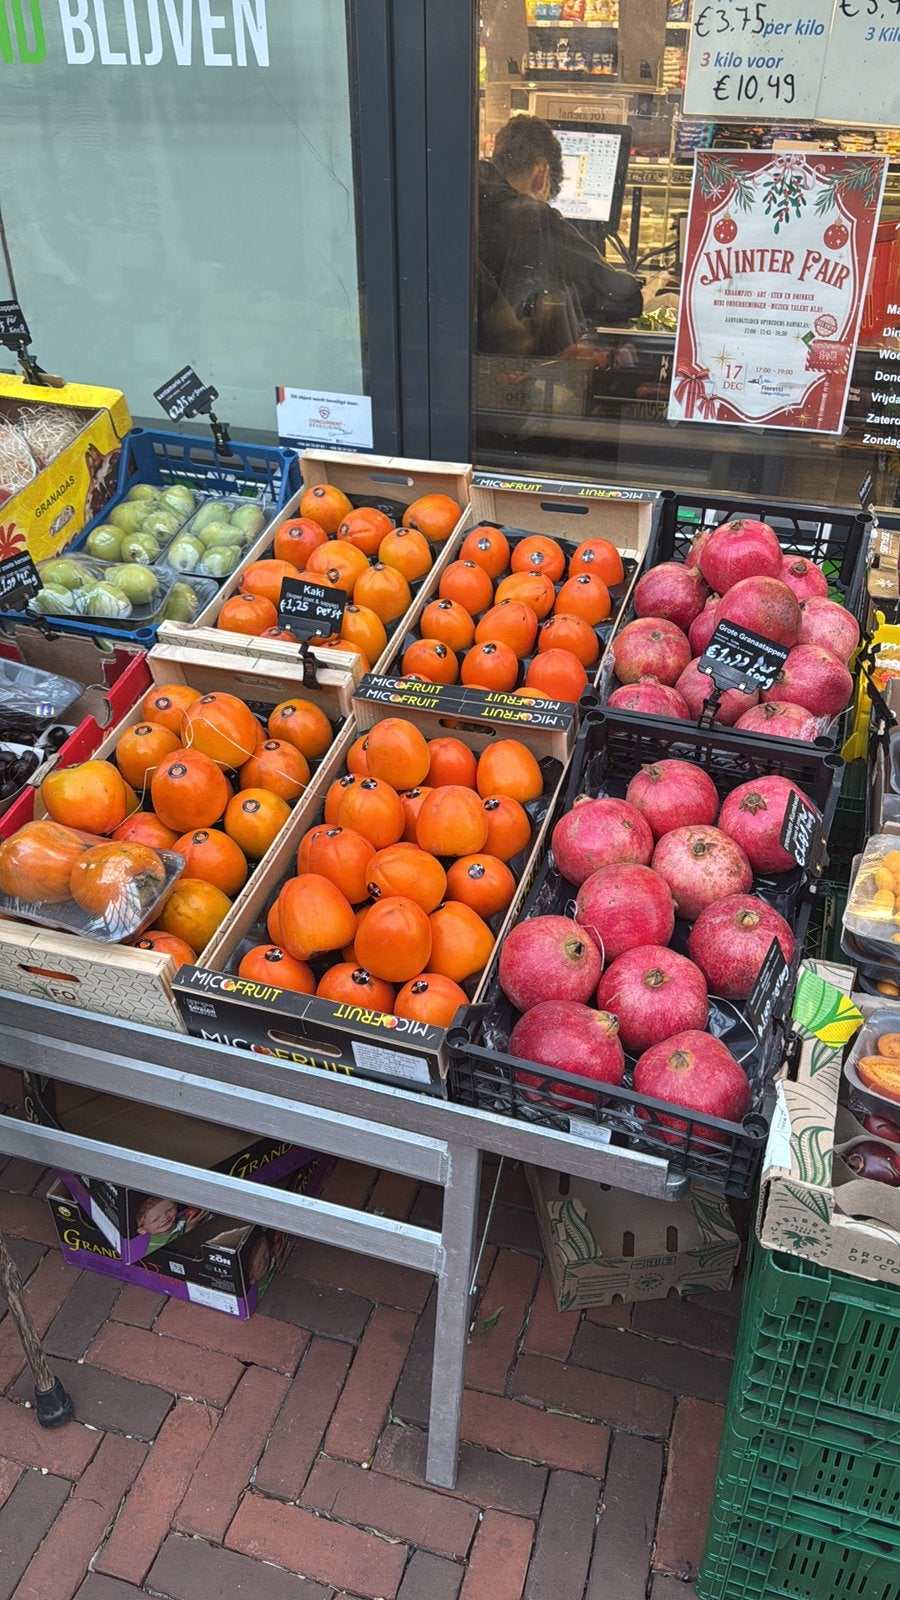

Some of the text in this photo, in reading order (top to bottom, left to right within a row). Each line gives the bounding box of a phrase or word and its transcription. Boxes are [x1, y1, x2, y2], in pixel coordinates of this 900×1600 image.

[59, 0, 270, 67] BLIJVEN
[763, 22, 792, 38] per
[795, 19, 824, 36] kilo
[865, 27, 876, 41] 3
[700, 51, 784, 69] 3 kilo voor
[756, 290, 767, 298] ART
[770, 290, 783, 299] ETEN
[784, 291, 791, 299] EN
[723, 364, 744, 391] 17 DEC
[479, 478, 542, 491] MICOFRUIT
[578, 487, 643, 500] MICOFRUIT
[35, 475, 75, 518] GRANADAS
[303, 584, 325, 598] Kaki
[718, 623, 738, 637] Grote
[739, 632, 788, 660] Granaatappels
[371, 676, 444, 695] MICOFRUIT
[366, 689, 439, 708] MICOFRUIT
[487, 692, 560, 711] MICOFRUIT
[481, 707, 558, 726] MICOFRUIT
[190, 969, 283, 1002] MICOFRUIT
[333, 1003, 429, 1034] MICOFRUIT
[848, 1255, 869, 1264] OF
[850, 1248, 900, 1267] PROD
